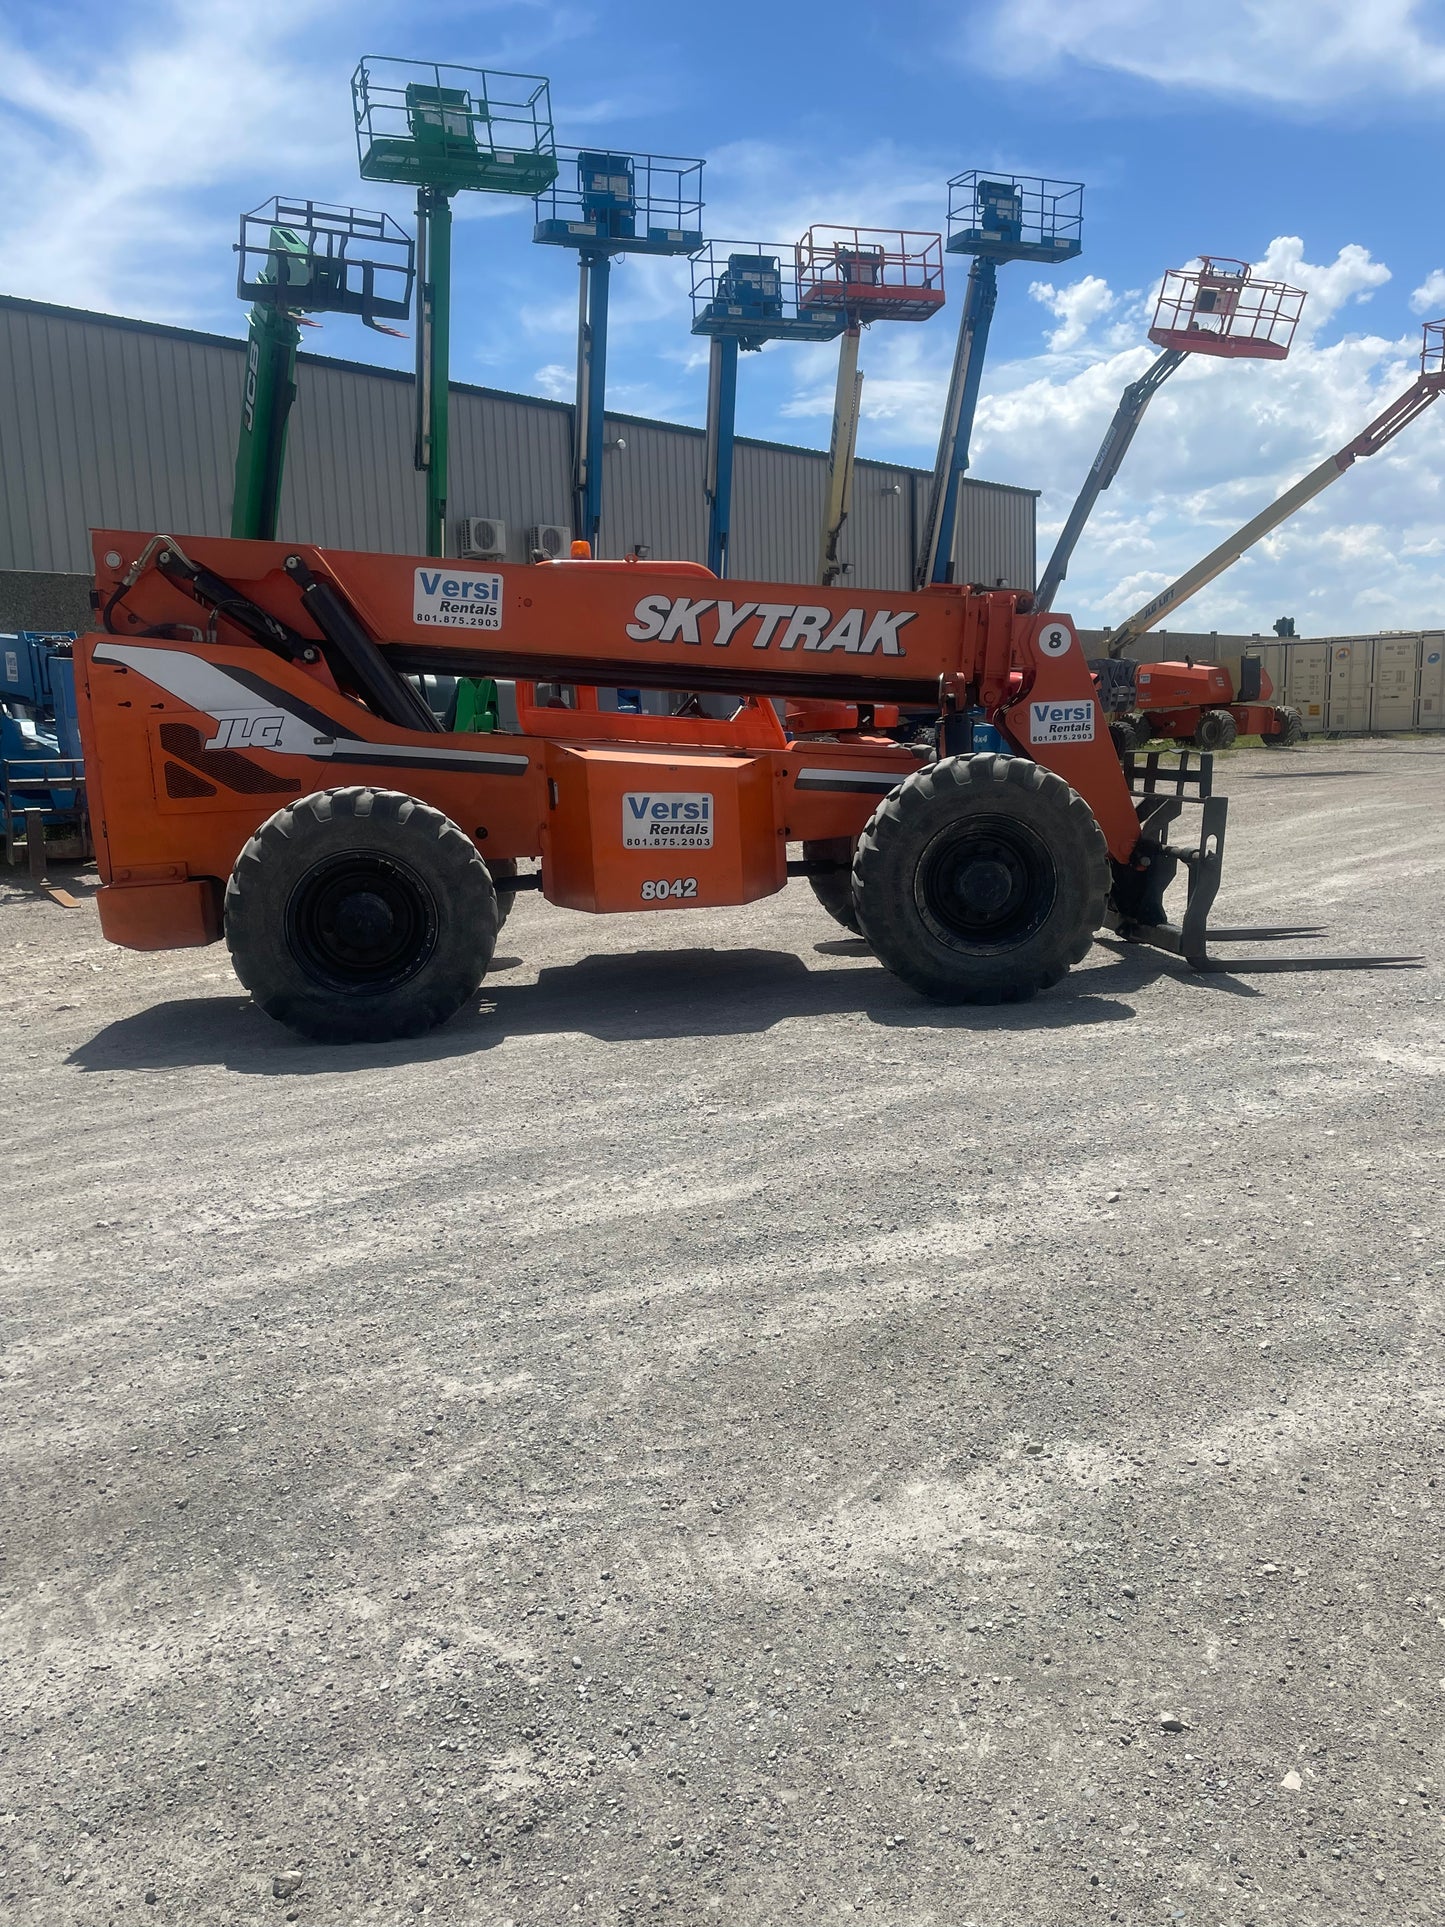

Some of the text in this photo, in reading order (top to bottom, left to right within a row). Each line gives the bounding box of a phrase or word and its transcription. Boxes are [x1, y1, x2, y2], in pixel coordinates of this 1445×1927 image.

[244, 340, 259, 431] JCB
[419, 572, 499, 600] Versi
[439, 601, 498, 616] Rentals
[1144, 589, 1175, 620] JLG LIFT
[417, 613, 499, 628] 801.875.2903
[625, 594, 919, 656] SKYTRAK
[1048, 631, 1062, 648] 8
[1033, 703, 1091, 722] Versi
[204, 716, 285, 751] JLG
[1049, 722, 1091, 733] Rentals
[973, 734, 988, 743] 4x4
[1032, 733, 1093, 742] 801.875.2903
[627, 797, 709, 820] Versi
[649, 823, 708, 835] Rentals
[626, 838, 710, 846] 801.875.2903
[641, 877, 698, 900] 8042
